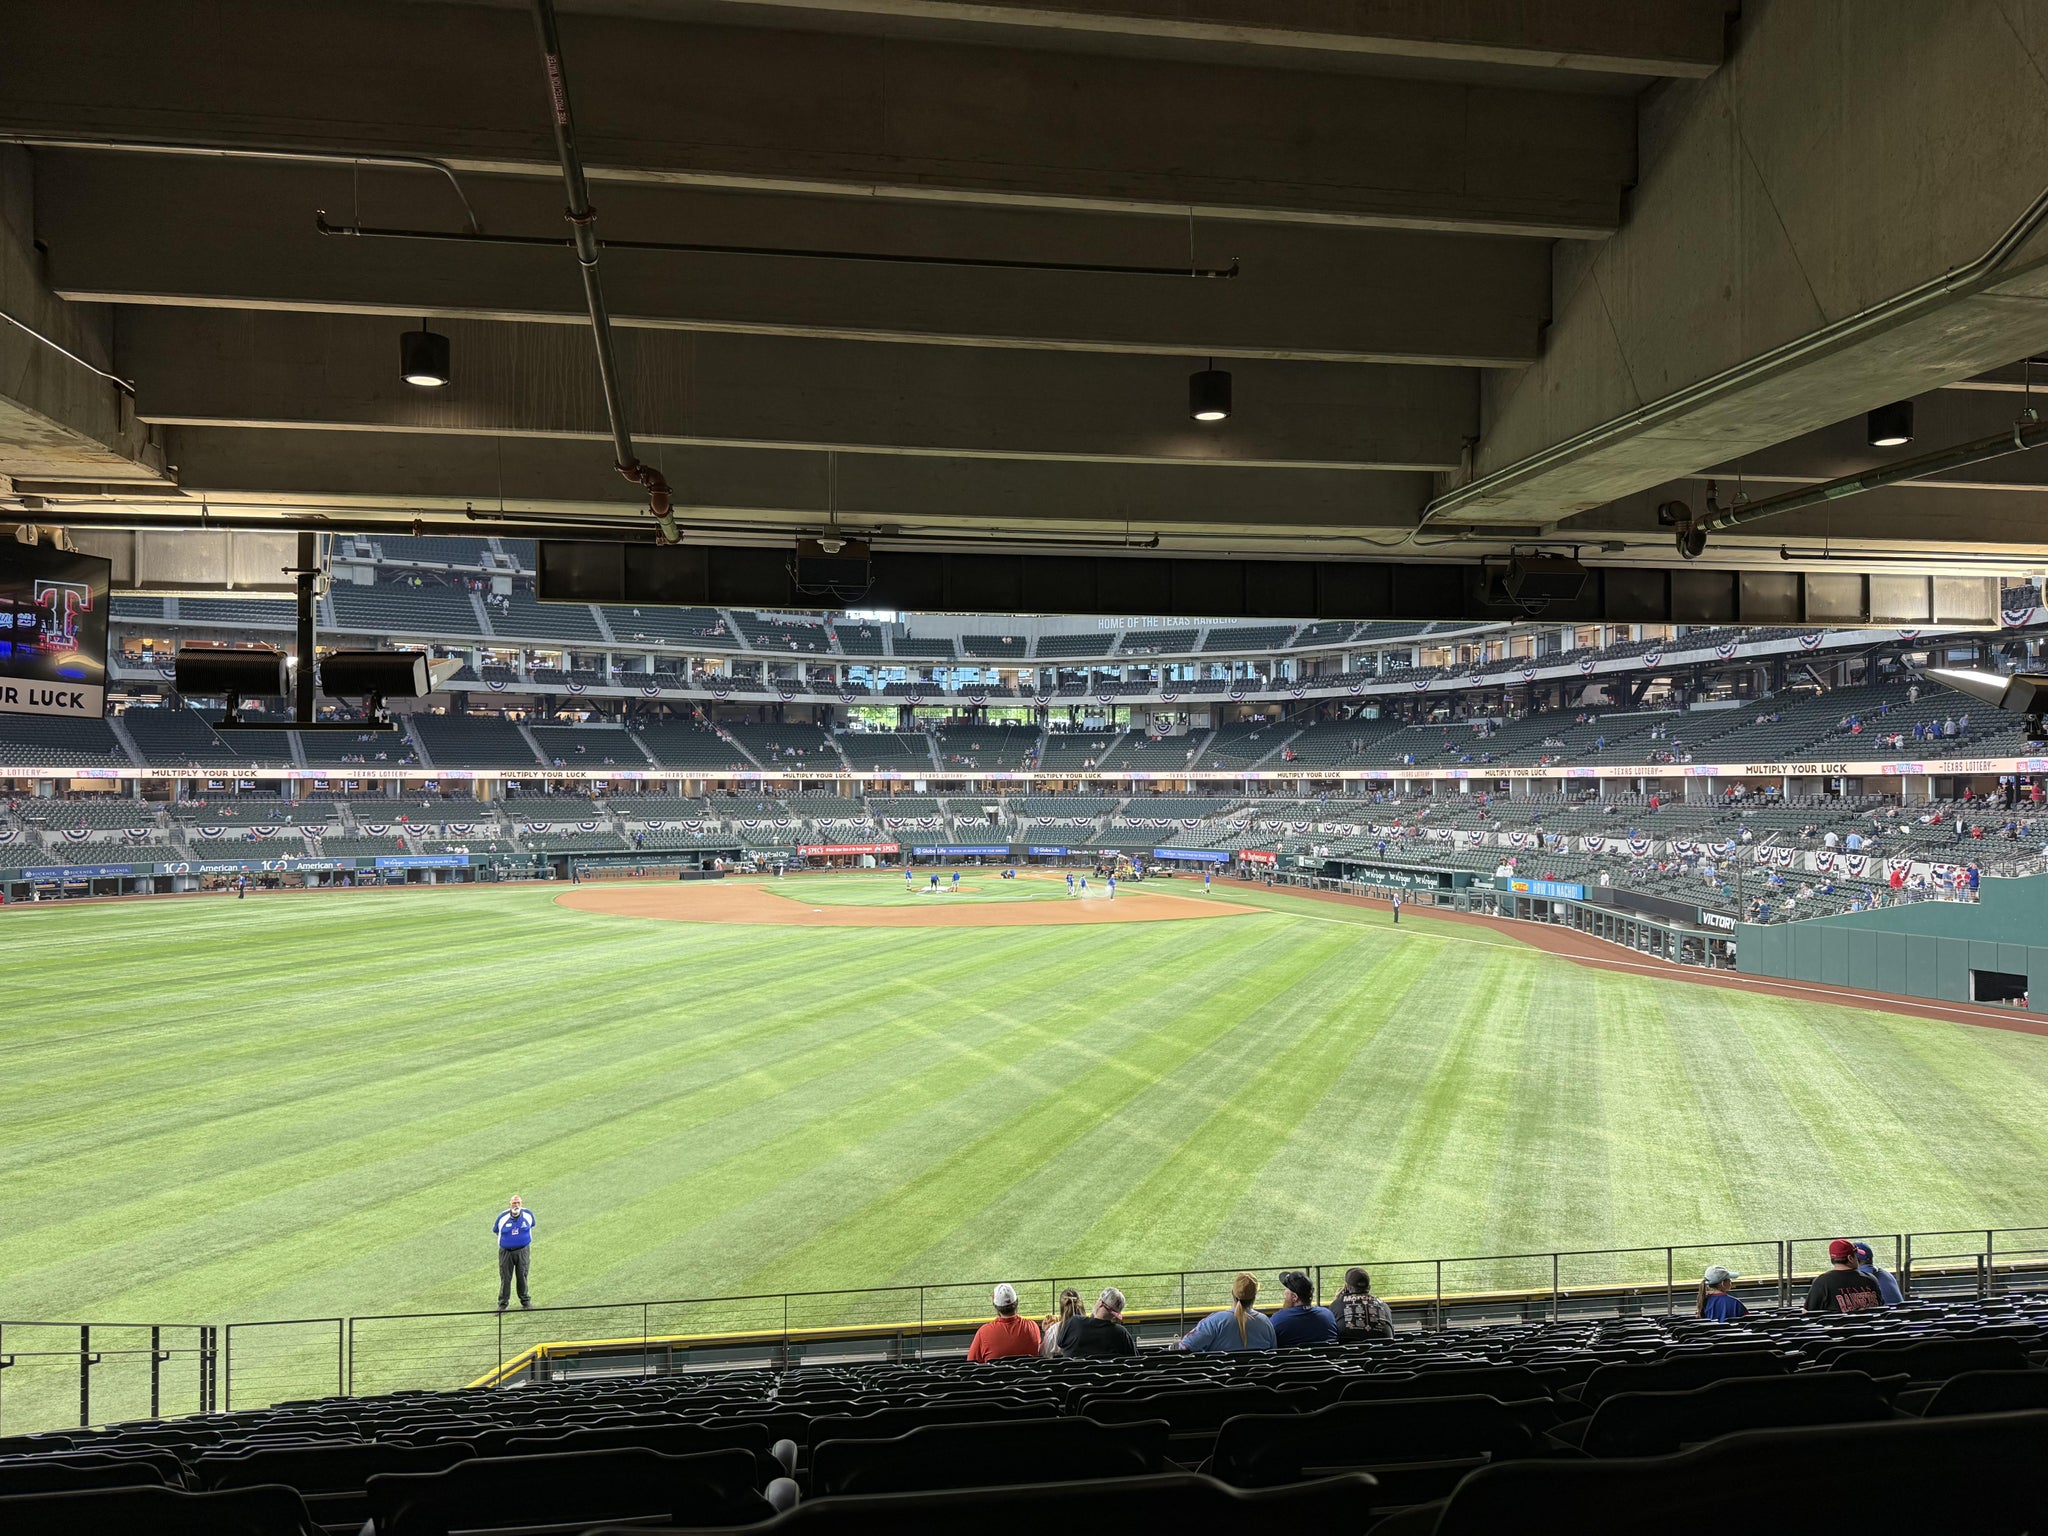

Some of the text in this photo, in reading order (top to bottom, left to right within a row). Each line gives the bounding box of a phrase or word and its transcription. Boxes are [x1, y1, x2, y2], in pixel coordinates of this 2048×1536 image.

[1098, 618, 1125, 630] HOME
[1127, 617, 1139, 628] OF
[1141, 617, 1159, 627] THE
[29, 688, 85, 709] LUCK
[1746, 765, 1848, 774] MULTIPLY YOUR LUCK
[1966, 762, 1991, 772] LOTTERY
[1702, 912, 1736, 930] VICTORY
